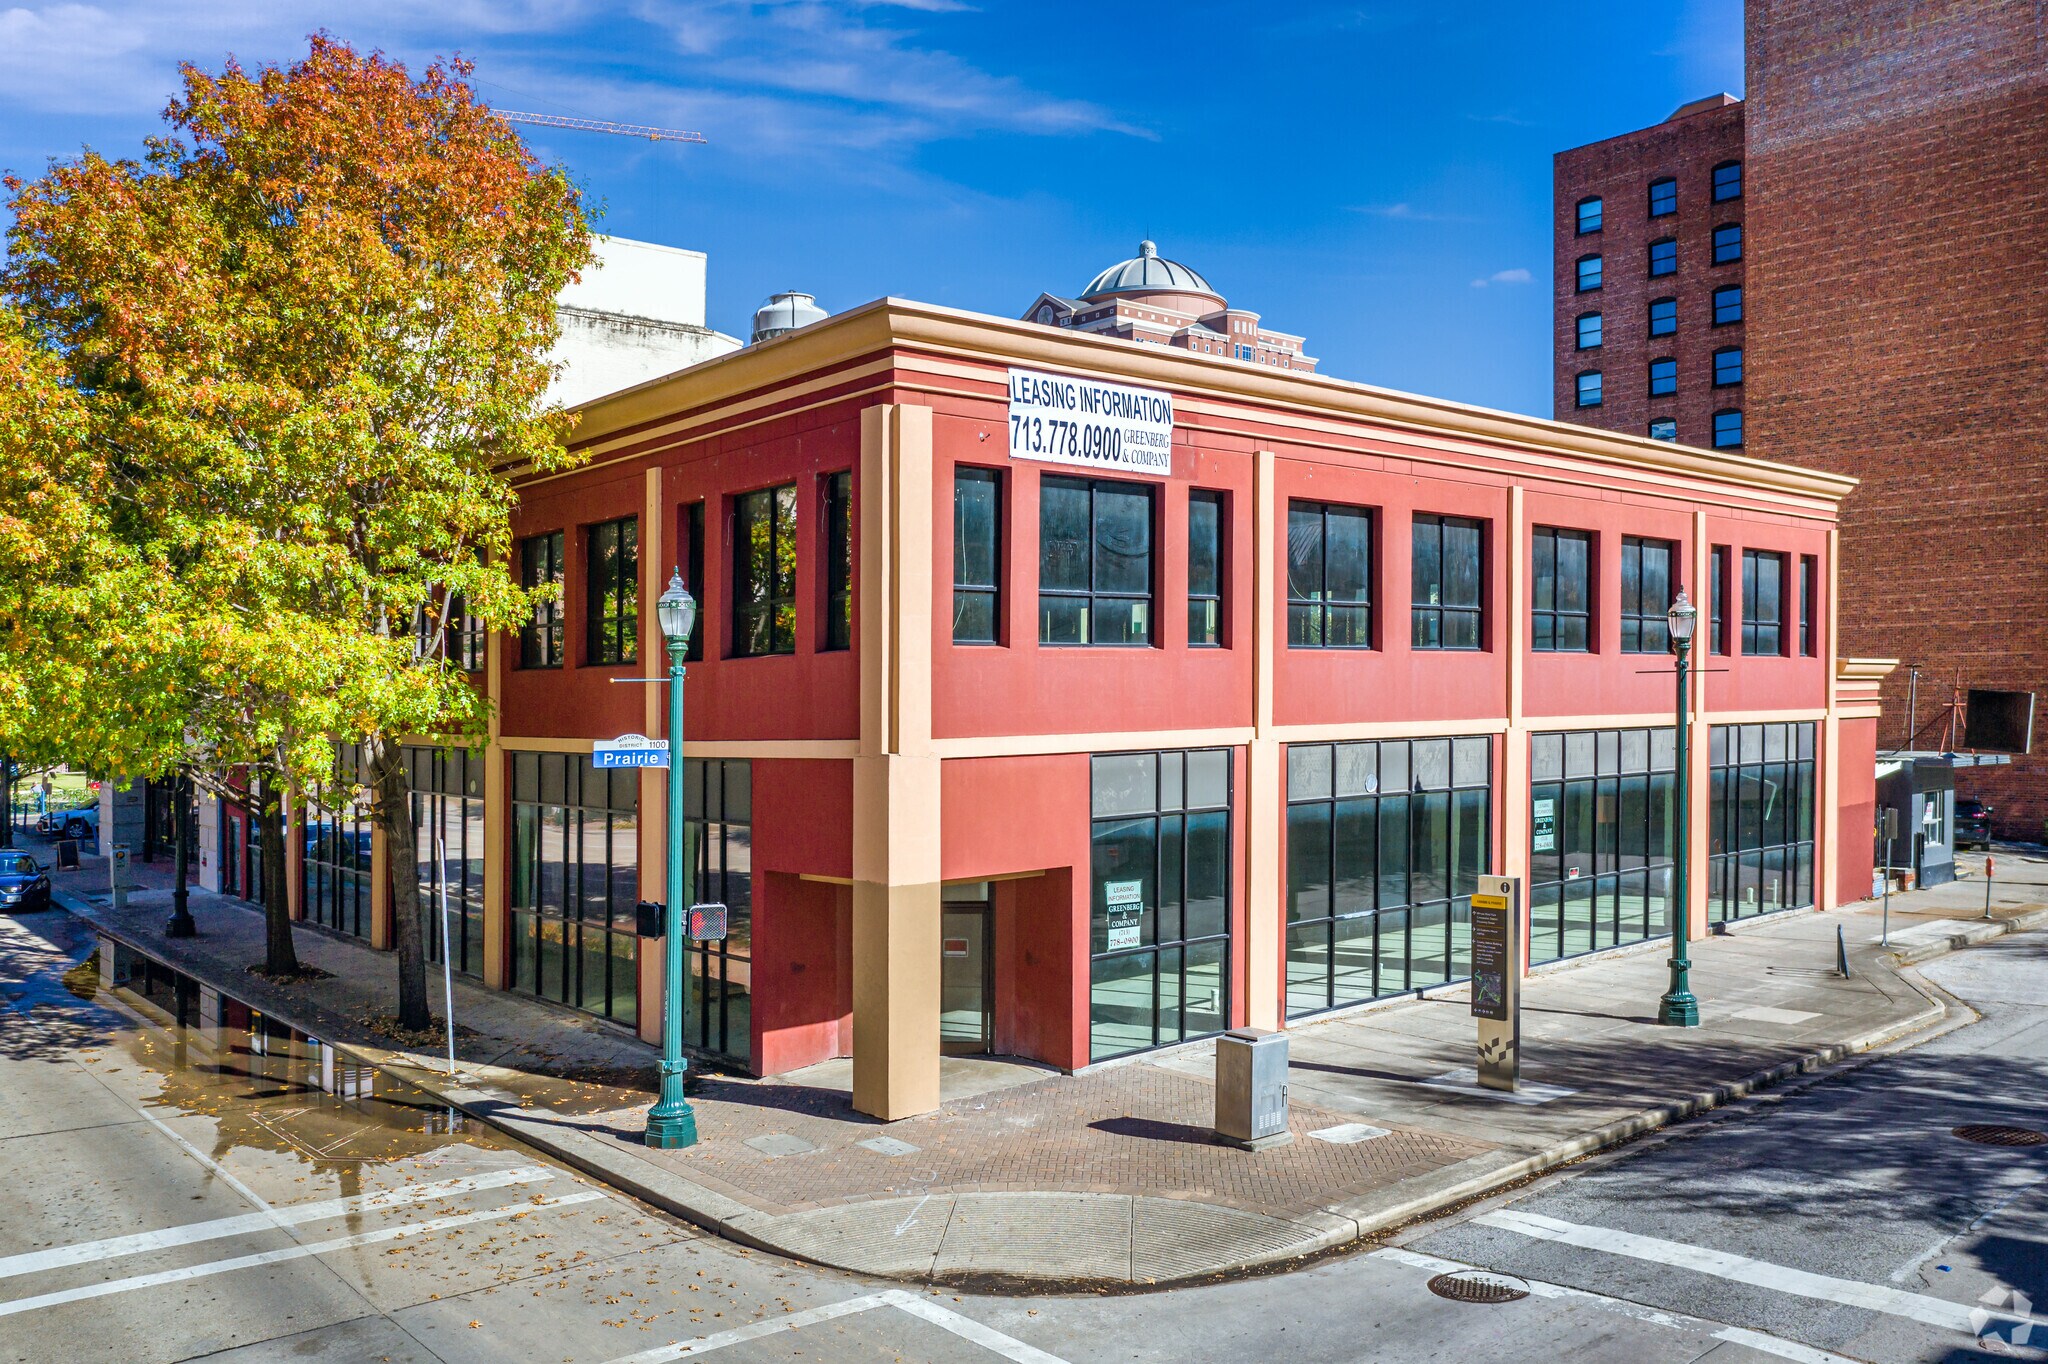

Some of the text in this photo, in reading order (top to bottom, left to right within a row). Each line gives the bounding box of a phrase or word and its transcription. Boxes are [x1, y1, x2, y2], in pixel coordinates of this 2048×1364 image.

[1012, 375, 1171, 424] LEASING INFORMATION
[1011, 414, 1121, 462] 713.778.0900
[1123, 428, 1170, 449] GREENBERG
[1122, 449, 1170, 468] & COMPANY
[618, 735, 644, 743] HISTORIC
[603, 752, 659, 765] Prairie
[1108, 903, 1140, 913] GREENBERG
[1111, 919, 1138, 928] COMPANY
[1109, 936, 1139, 947] 778-0900
